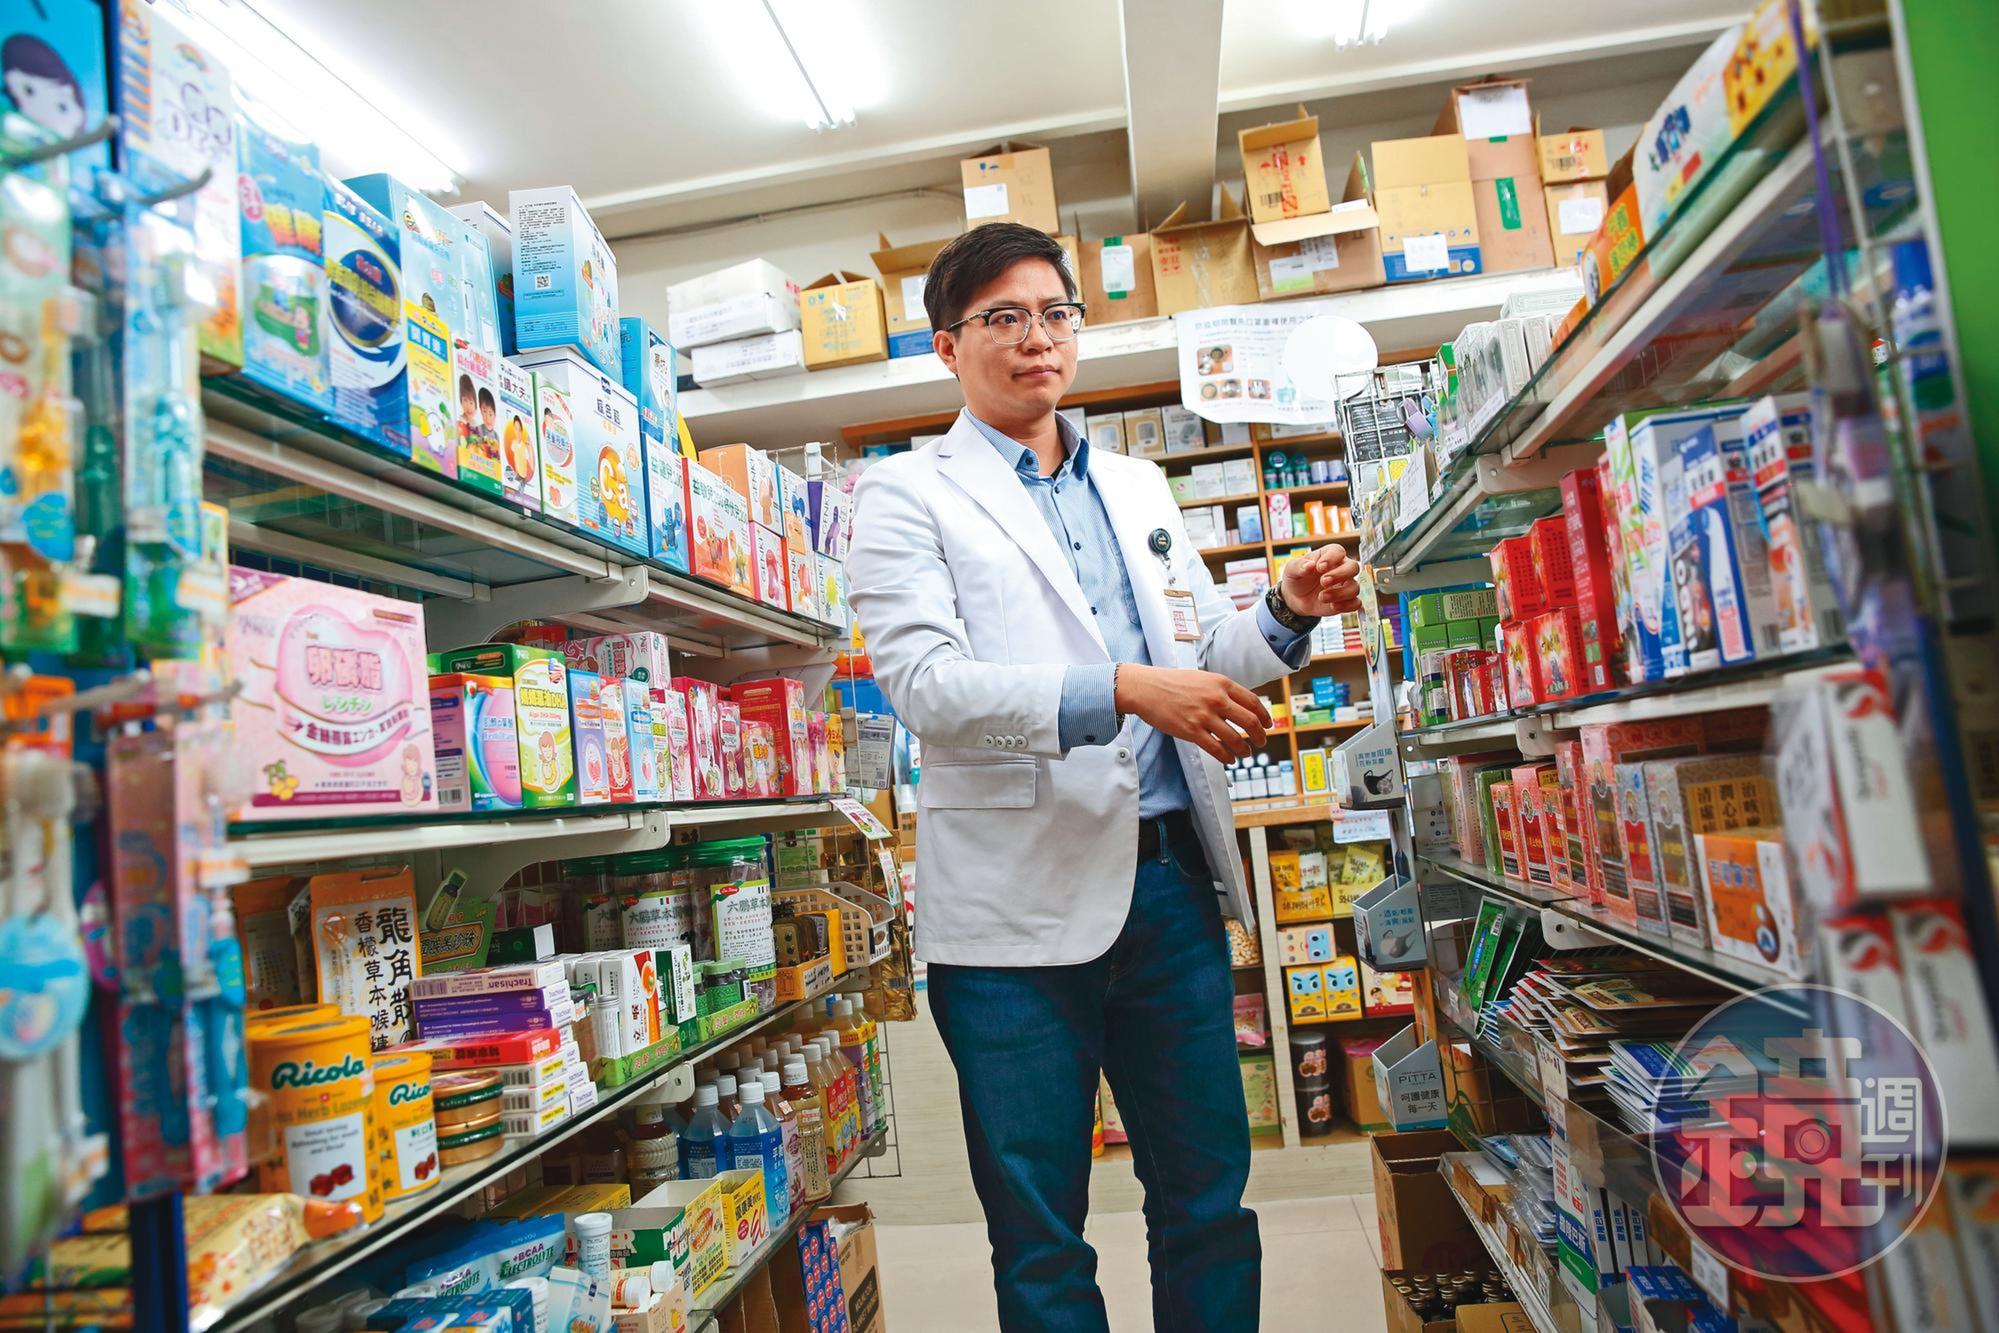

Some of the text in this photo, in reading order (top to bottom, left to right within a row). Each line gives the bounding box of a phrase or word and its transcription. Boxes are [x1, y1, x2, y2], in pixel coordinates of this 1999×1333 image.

[489, 976, 533, 989] Trachisan
[271, 1055, 364, 1090] Ricola
[1399, 1072, 1437, 1084] PITTA
[1400, 1089, 1439, 1102] 呵護健康
[1408, 1102, 1437, 1113] 每一天
[513, 1242, 535, 1262] +BCAA
